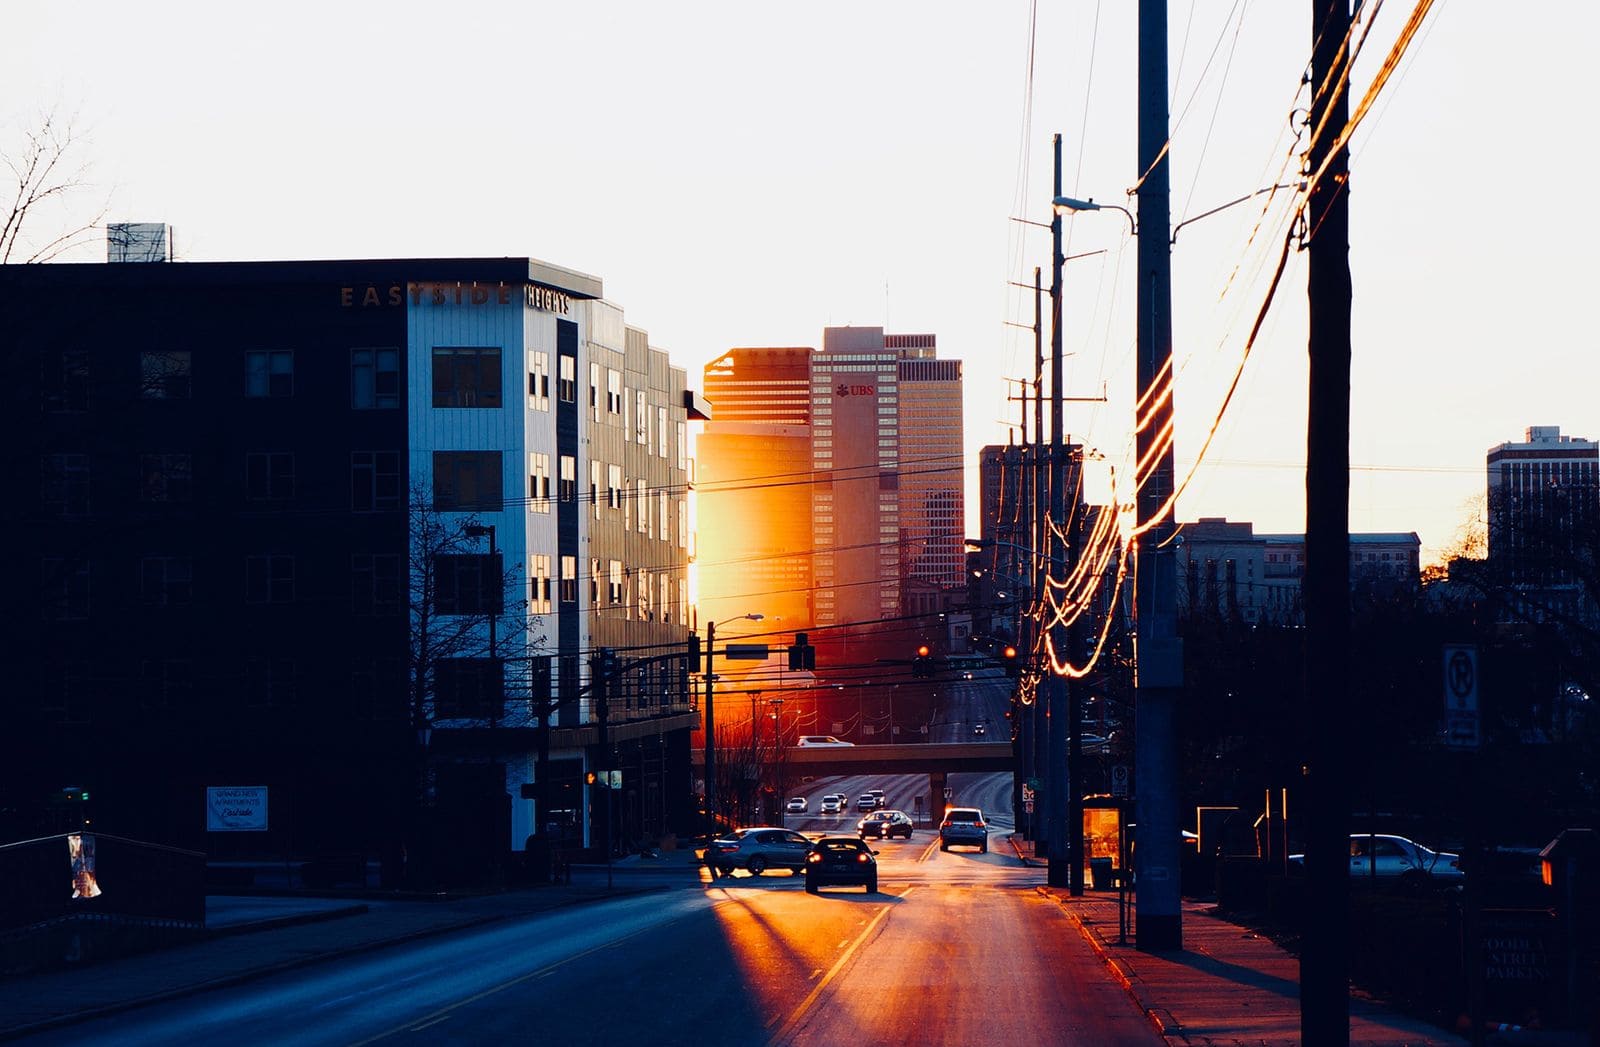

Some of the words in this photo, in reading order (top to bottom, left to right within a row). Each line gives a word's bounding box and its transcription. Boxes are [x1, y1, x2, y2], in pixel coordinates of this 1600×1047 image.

[340, 285, 510, 307] EASTSIDE
[526, 286, 569, 315] HEIGHTS
[850, 385, 874, 396] UBS
